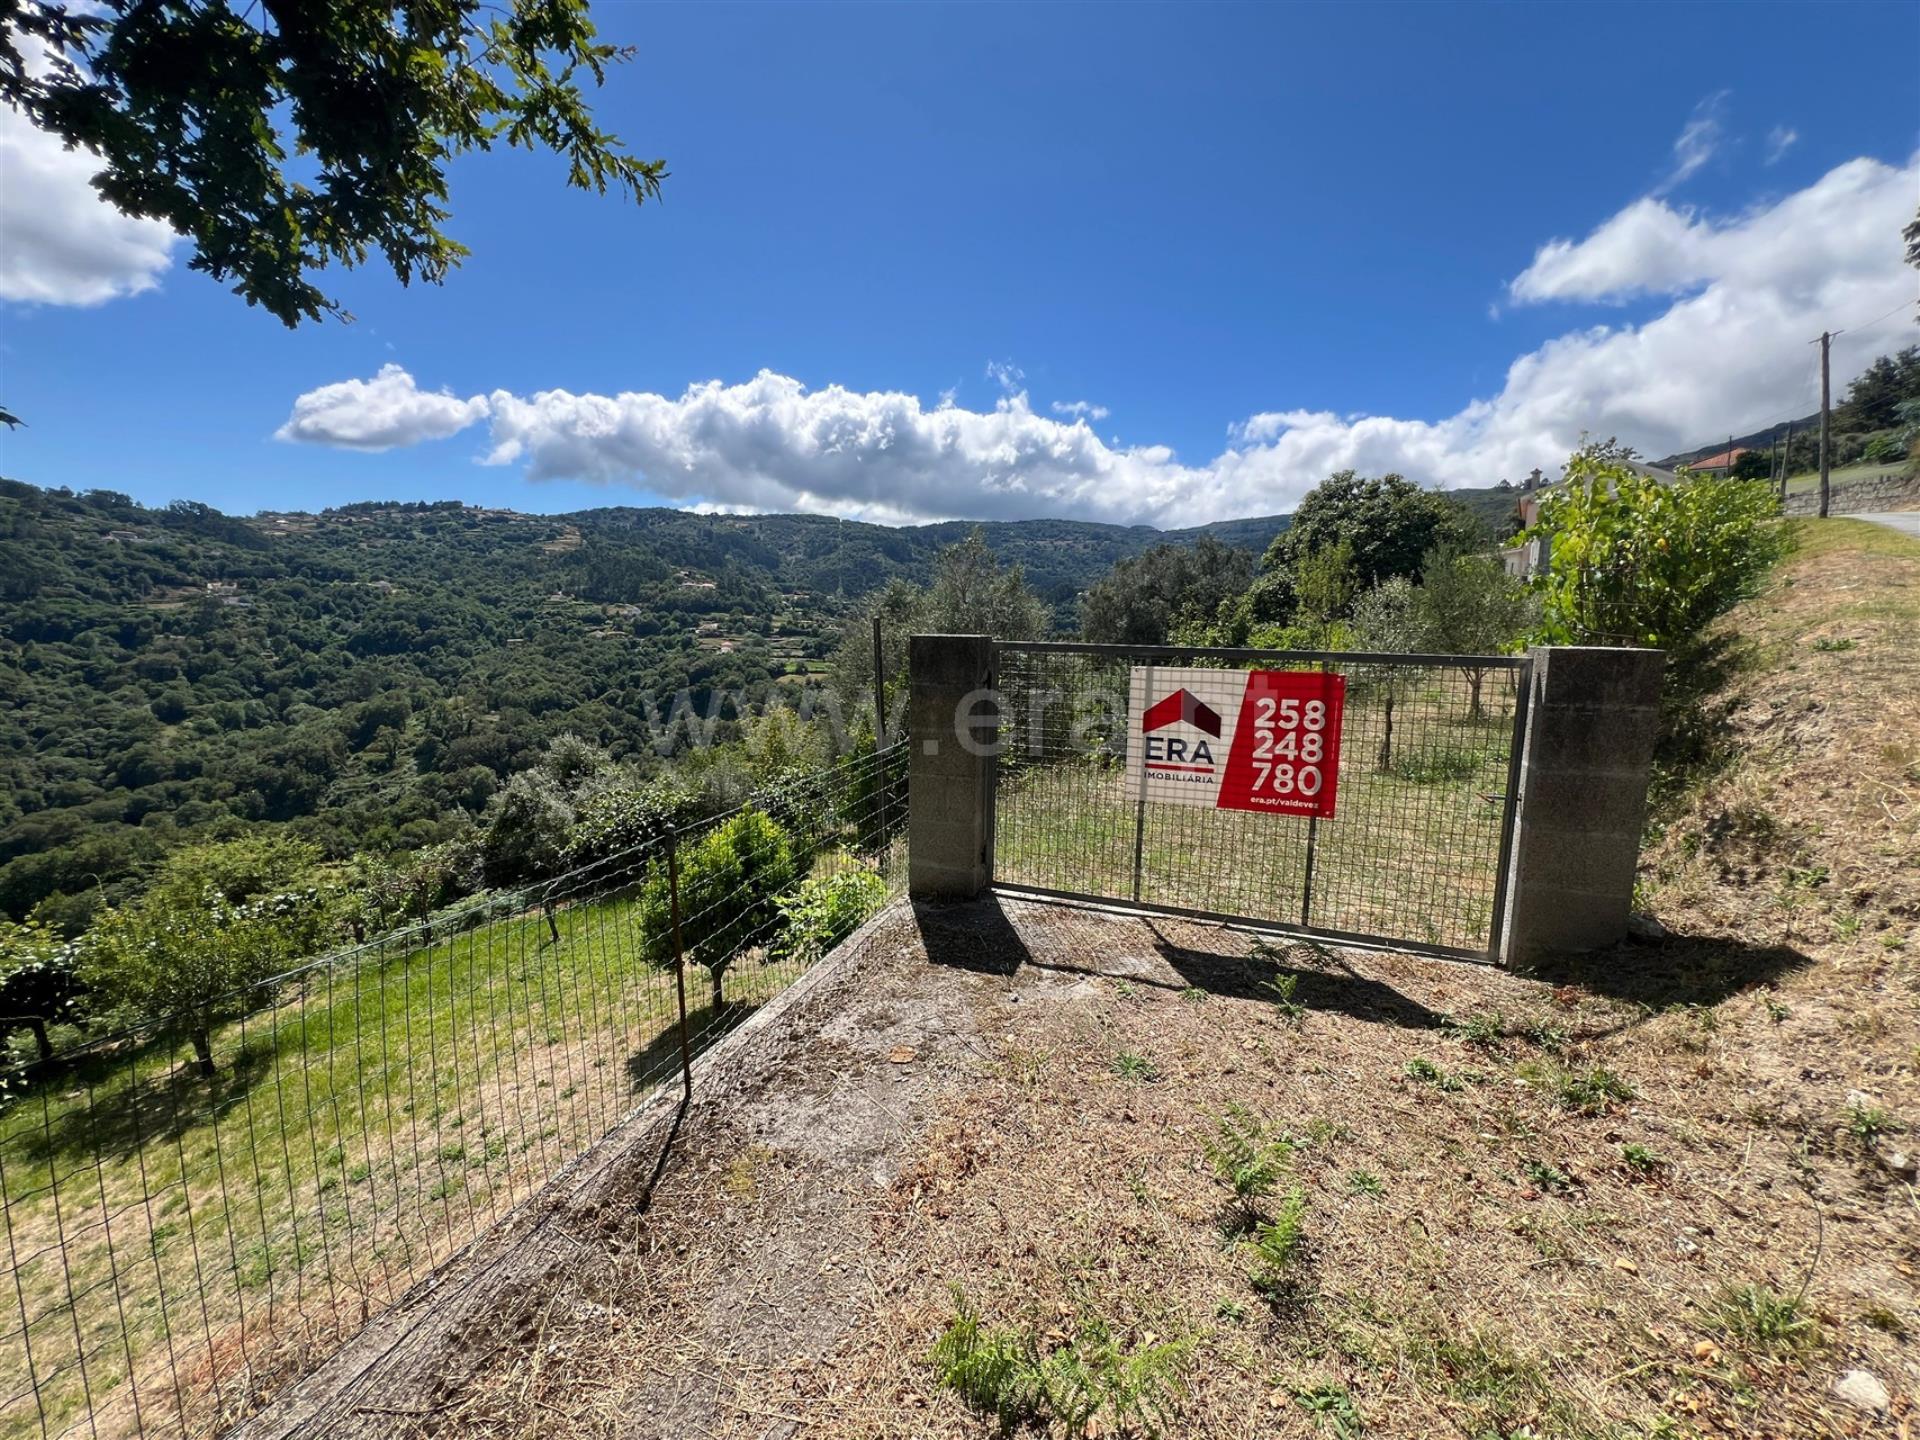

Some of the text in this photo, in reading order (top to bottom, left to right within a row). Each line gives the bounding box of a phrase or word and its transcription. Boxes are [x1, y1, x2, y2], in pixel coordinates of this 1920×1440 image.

[1254, 697, 1326, 731] 258
[1145, 736, 1214, 765] ERA
[1252, 730, 1323, 763] 248
[1144, 771, 1214, 785] IMOBILIÁRIA
[1251, 762, 1322, 796] 780
[1250, 796, 1319, 809] era.pt/valdevez
